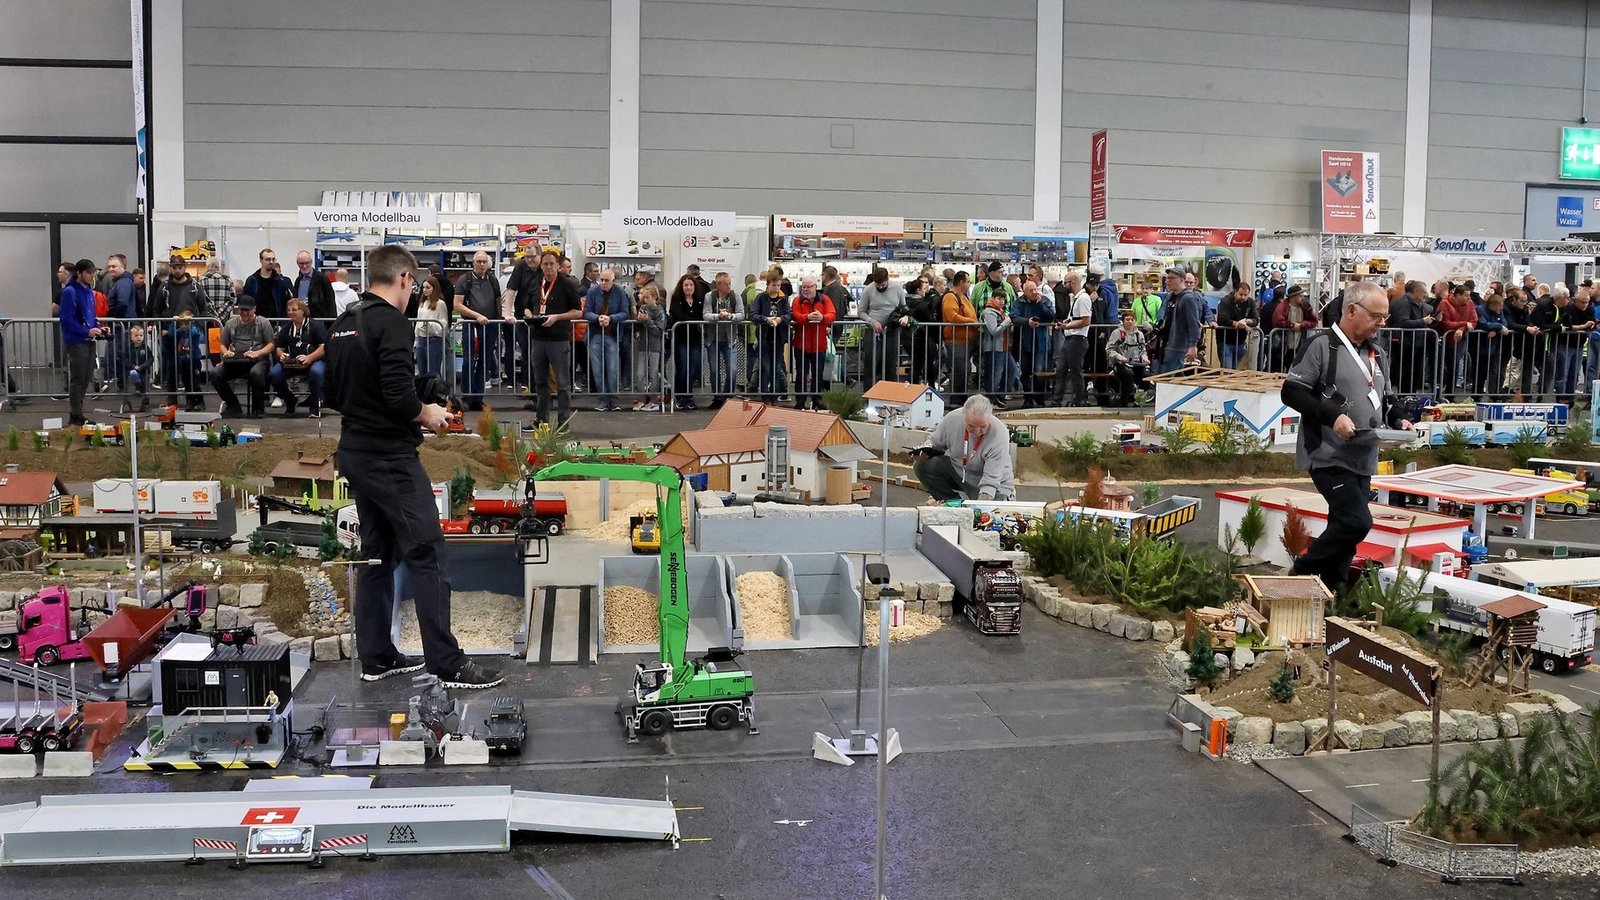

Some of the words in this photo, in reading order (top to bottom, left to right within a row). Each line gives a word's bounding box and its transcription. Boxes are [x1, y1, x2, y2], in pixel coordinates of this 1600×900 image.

[313, 212, 359, 223] Veroma
[361, 211, 421, 224] Modellbau
[1559, 208, 1582, 216] Wasser
[623, 215, 713, 227] sicon-Modellbau
[1559, 218, 1578, 226] Water
[667, 552, 680, 606] SENNEBOGEN
[1358, 649, 1393, 673] Ausfahrt
